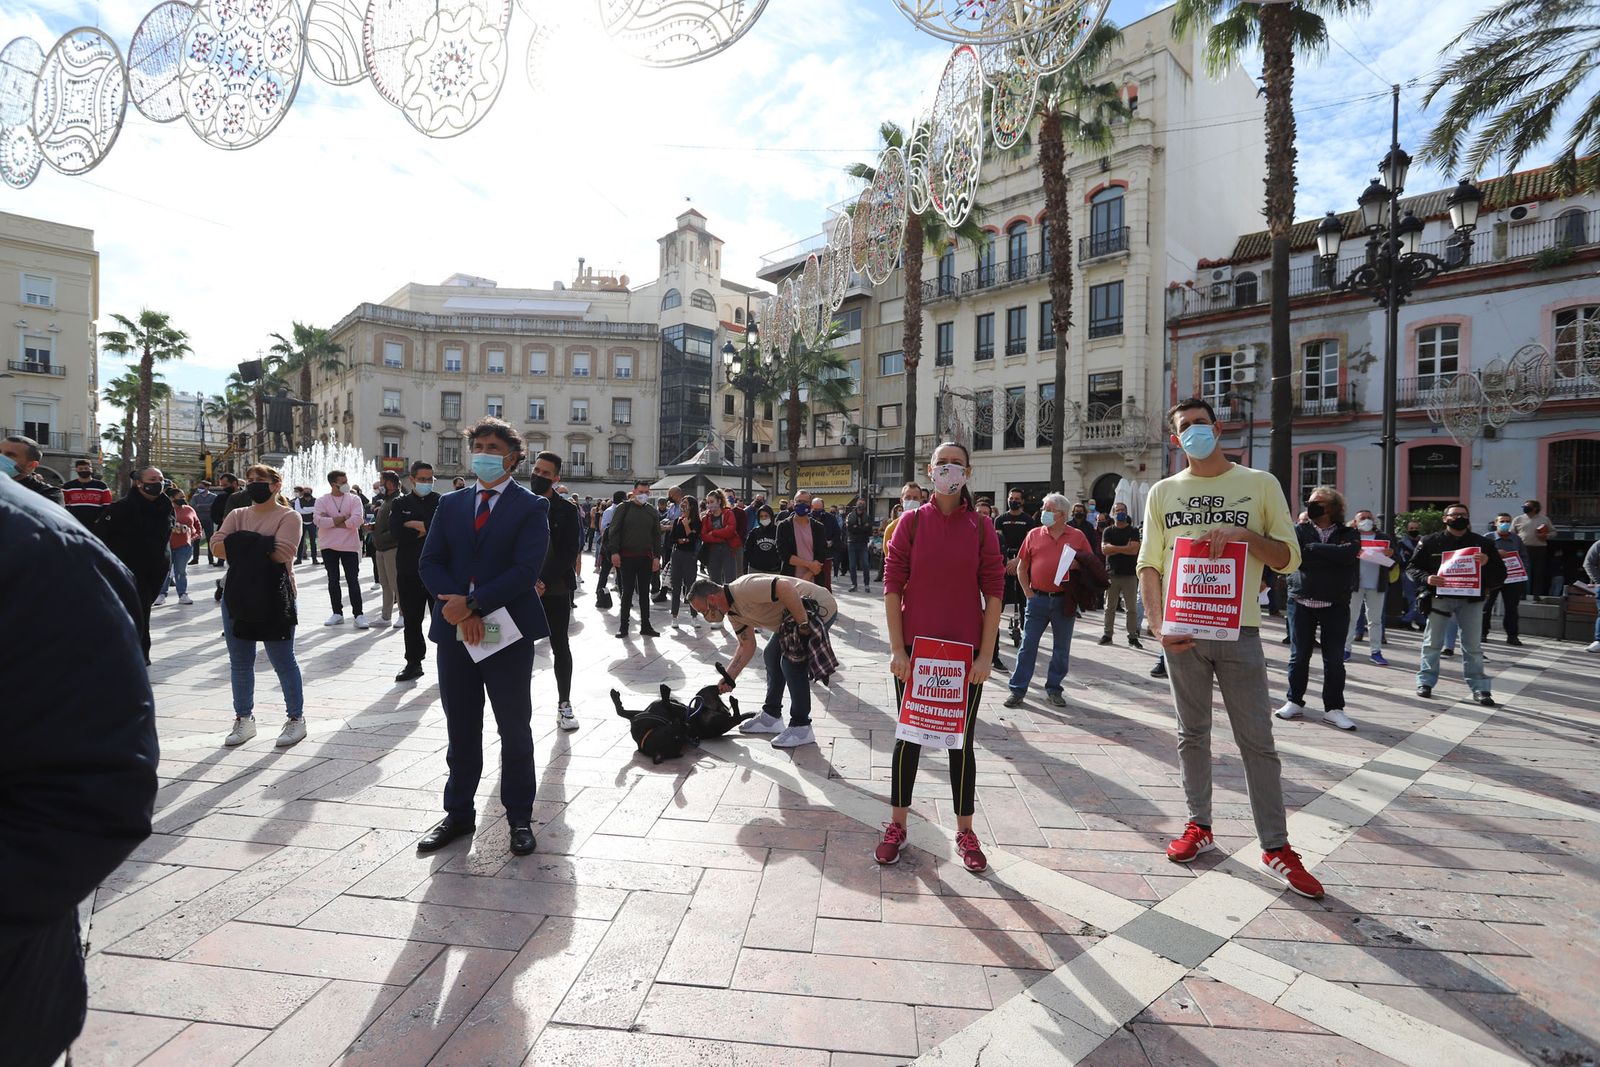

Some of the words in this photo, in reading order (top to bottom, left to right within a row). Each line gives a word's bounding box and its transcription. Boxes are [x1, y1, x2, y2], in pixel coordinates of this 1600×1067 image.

[1189, 496, 1224, 508] GRS
[1183, 564, 1196, 574] SIN
[1198, 564, 1231, 575] AYUDAS
[1191, 572, 1218, 585] Nos
[1182, 583, 1231, 595] Arruinan!
[1170, 599, 1238, 614] CONCENTRACIÓN
[918, 664, 931, 676] SIN
[932, 666, 962, 677] AYUDAS
[926, 673, 951, 688] Nos
[917, 684, 961, 699] Arruinan!
[905, 701, 964, 718] CONCENTRACIÓN
